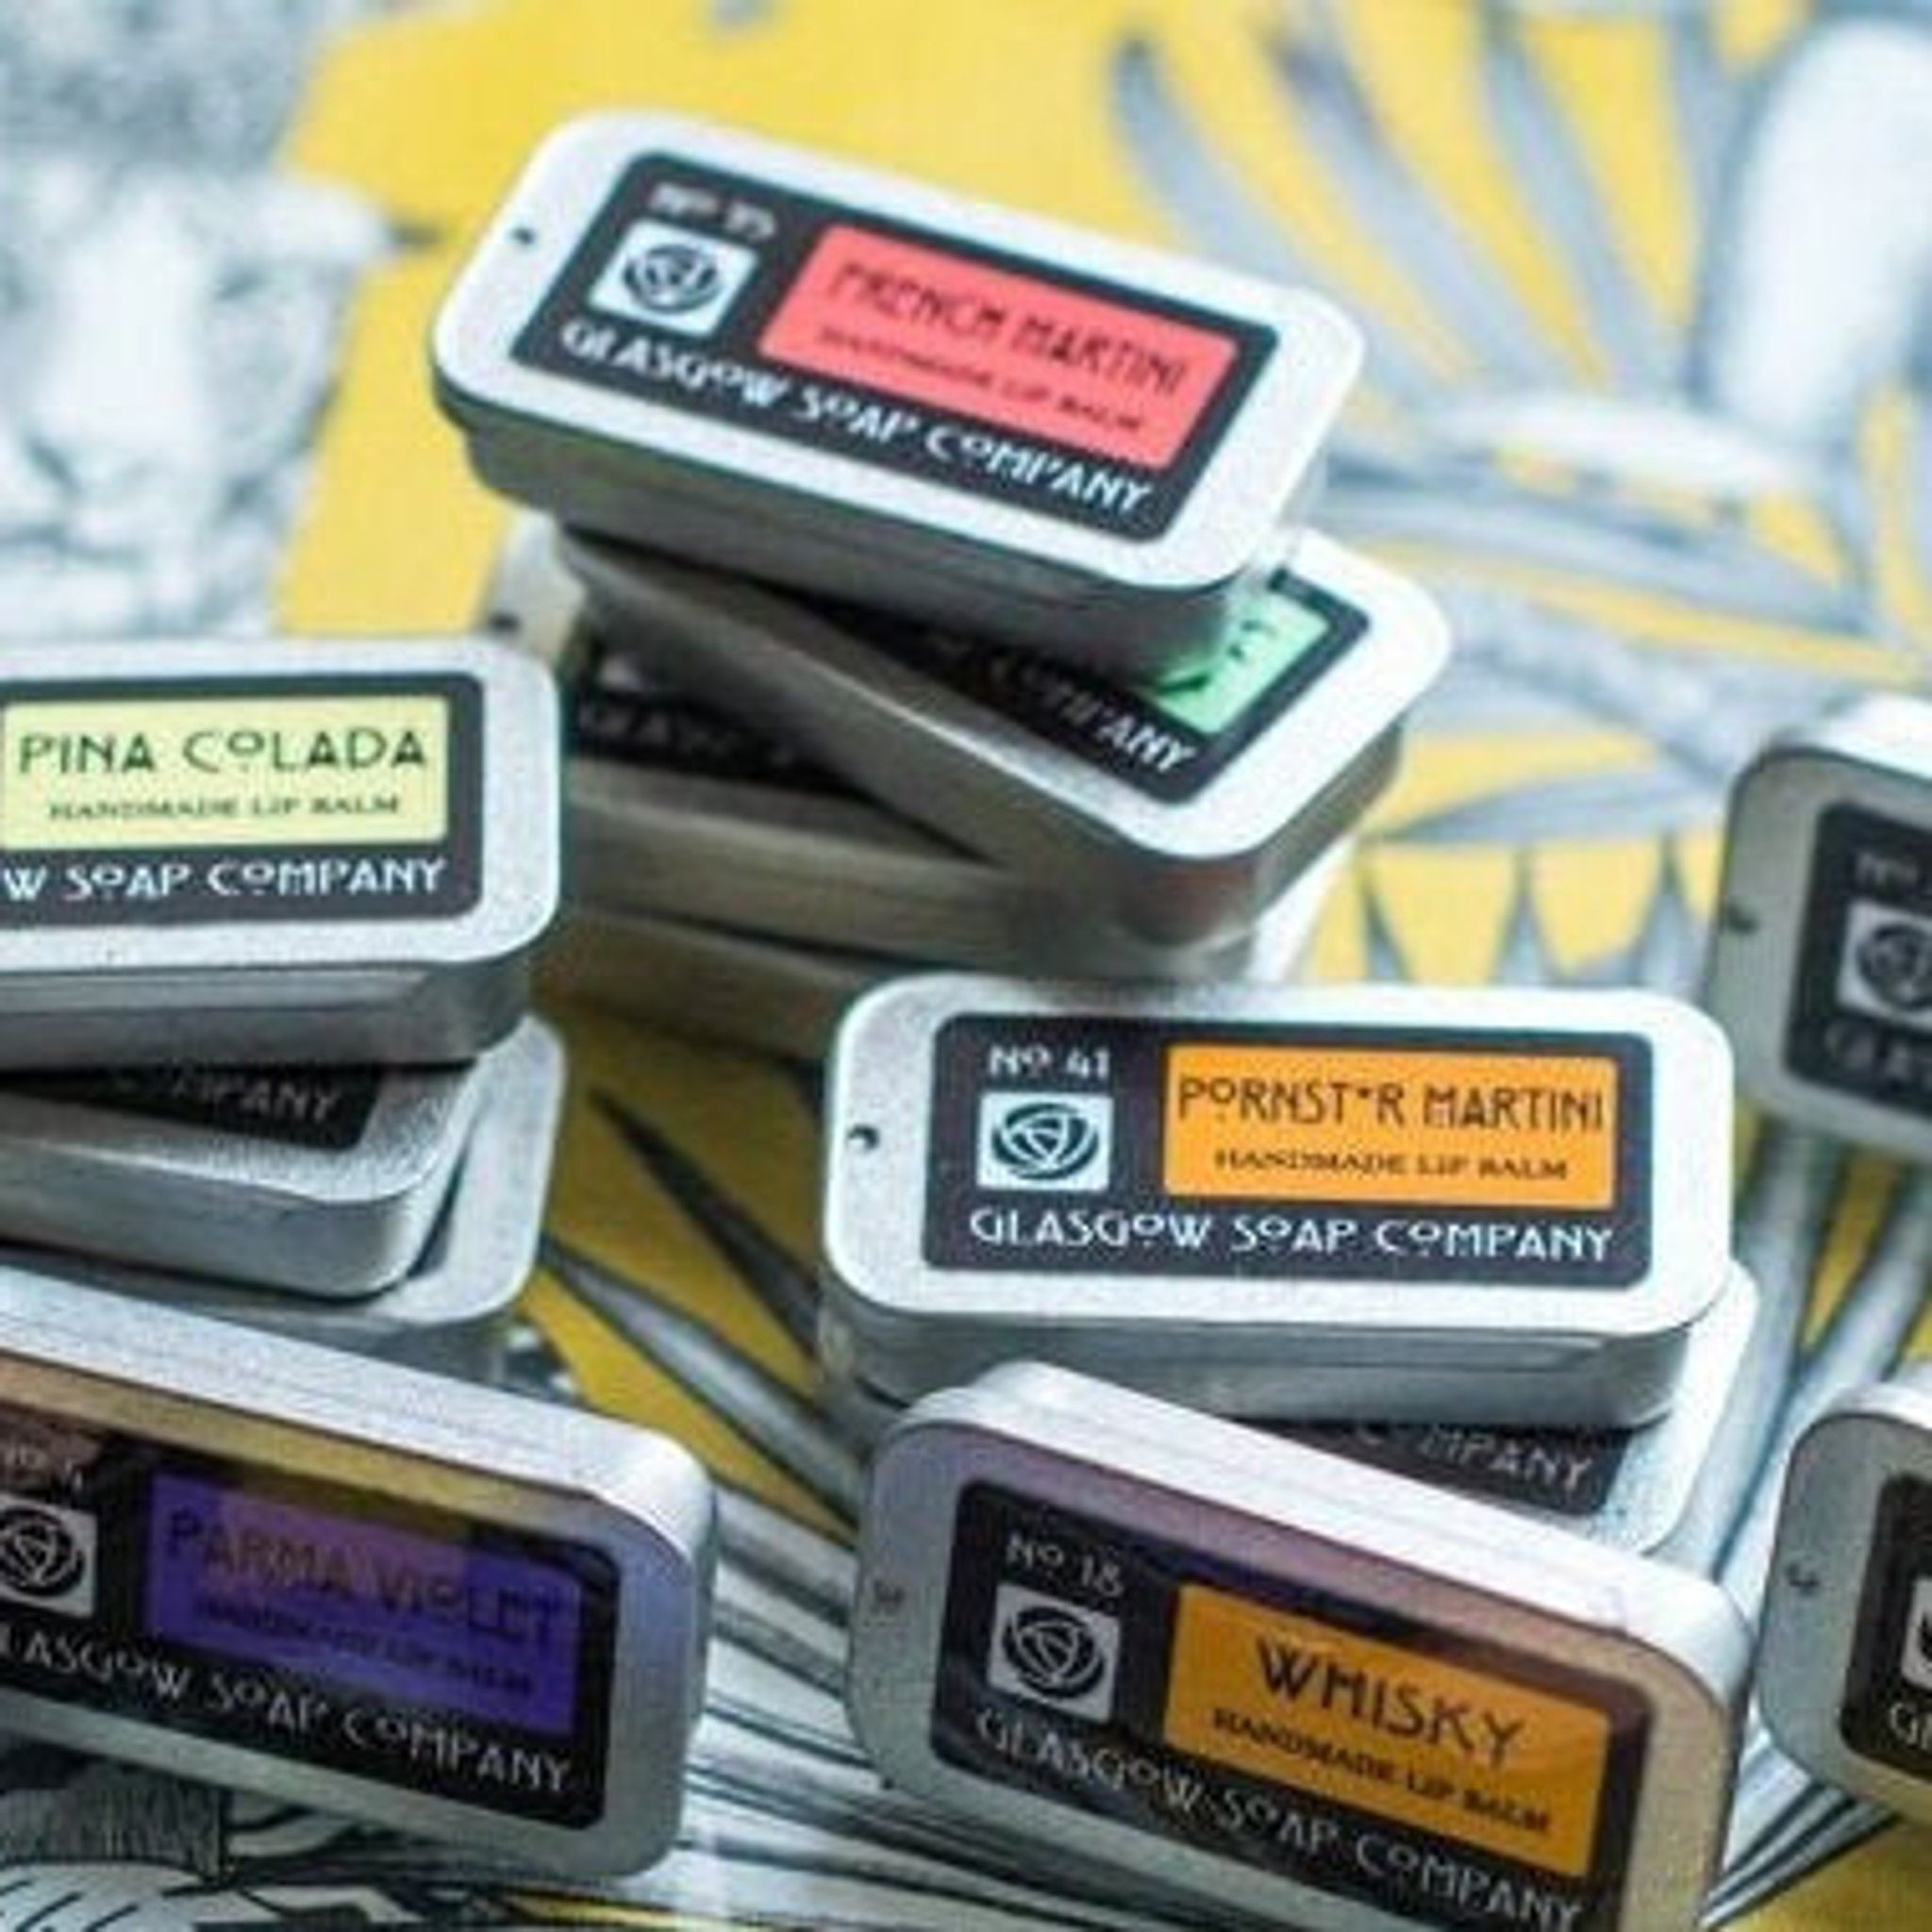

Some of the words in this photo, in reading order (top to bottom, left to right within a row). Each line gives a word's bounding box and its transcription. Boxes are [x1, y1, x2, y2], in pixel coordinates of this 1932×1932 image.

[1011, 312, 1187, 396] MARTINI
[19, 731, 156, 774] PINA
[182, 727, 428, 774] COLADA
[252, 797, 300, 817] LIP
[65, 860, 192, 902] SOAP
[206, 858, 448, 898] COMPANY
[1065, 1046, 1110, 1080] 41
[1424, 1082, 1604, 1134] MARTINI
[1214, 1146, 1407, 1178] HANDMADE
[1416, 1150, 1474, 1177] LIP
[1478, 1155, 1570, 1182] BALM
[970, 1207, 1213, 1249] GLASGOW
[1229, 1213, 1361, 1255] SOAP
[1375, 1217, 1614, 1261] COMPANY
[1078, 1545, 1124, 1598] 18
[0, 1621, 189, 1700] LASGOW
[343, 1707, 571, 1790] COMPANY
[1256, 1634, 1527, 1768] WHISKY
[1211, 1707, 1395, 1781] HANDMADE
